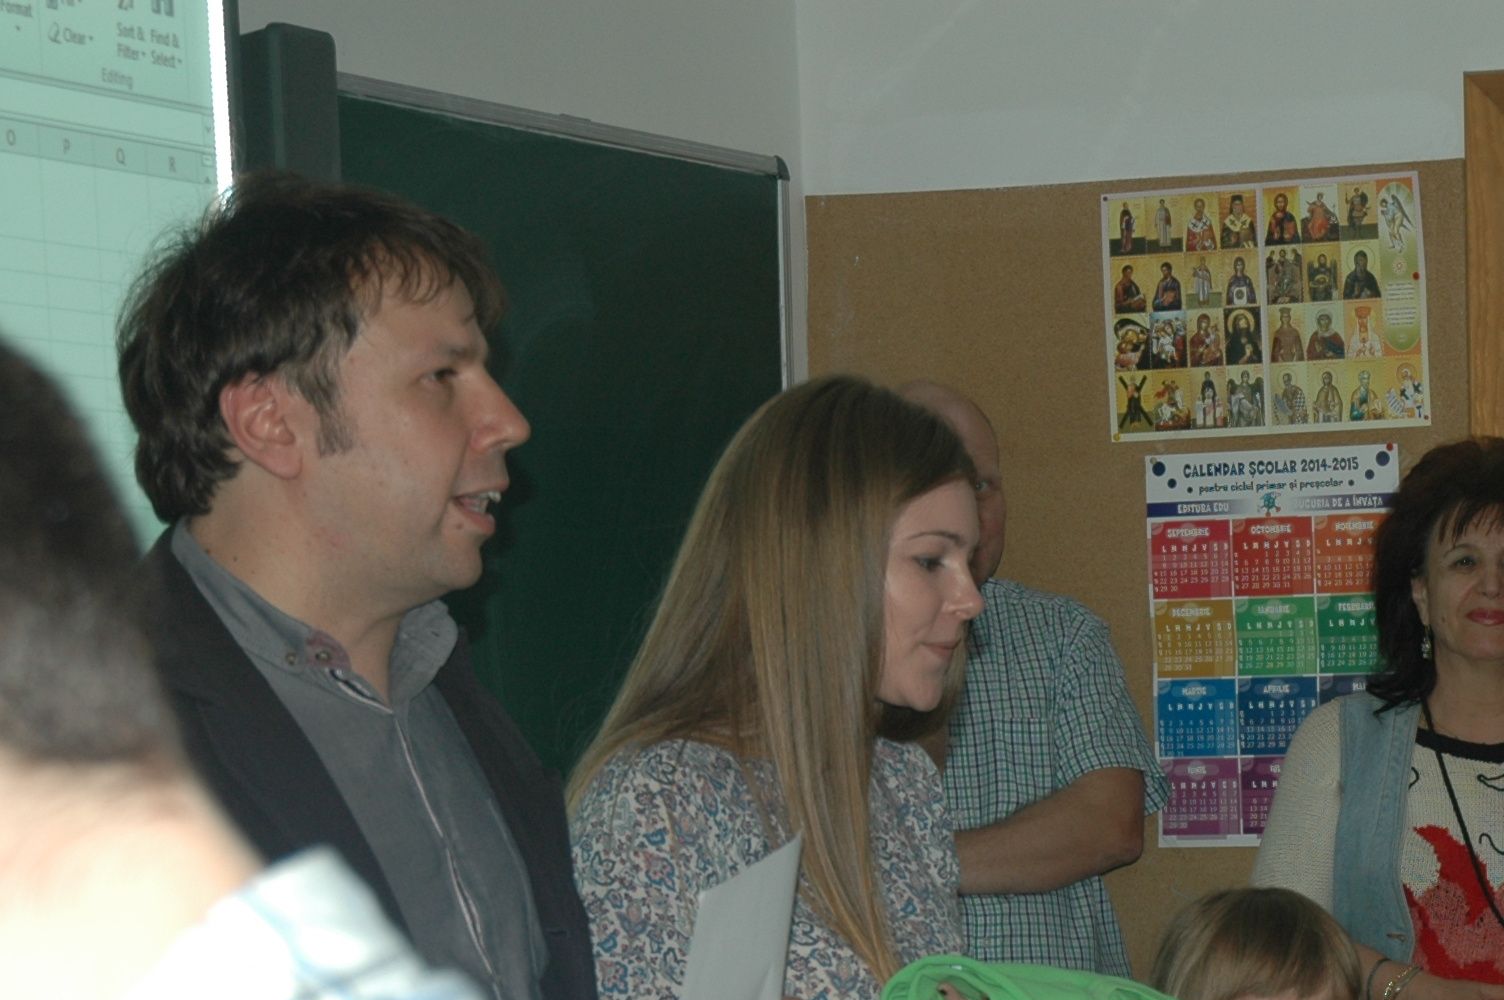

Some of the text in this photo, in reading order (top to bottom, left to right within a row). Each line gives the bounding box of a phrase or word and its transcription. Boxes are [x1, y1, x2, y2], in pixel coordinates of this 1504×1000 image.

[117, 22, 135, 40] Sort
[151, 29, 171, 47] Find
[117, 43, 140, 61] Filter
[151, 50, 176, 69] Select
[101, 67, 134, 90] Editing
[1183, 460, 1245, 479] CALENDAR
[1301, 456, 1359, 473] 2014-2015
[1177, 502, 1230, 515] EDITURA EDU
